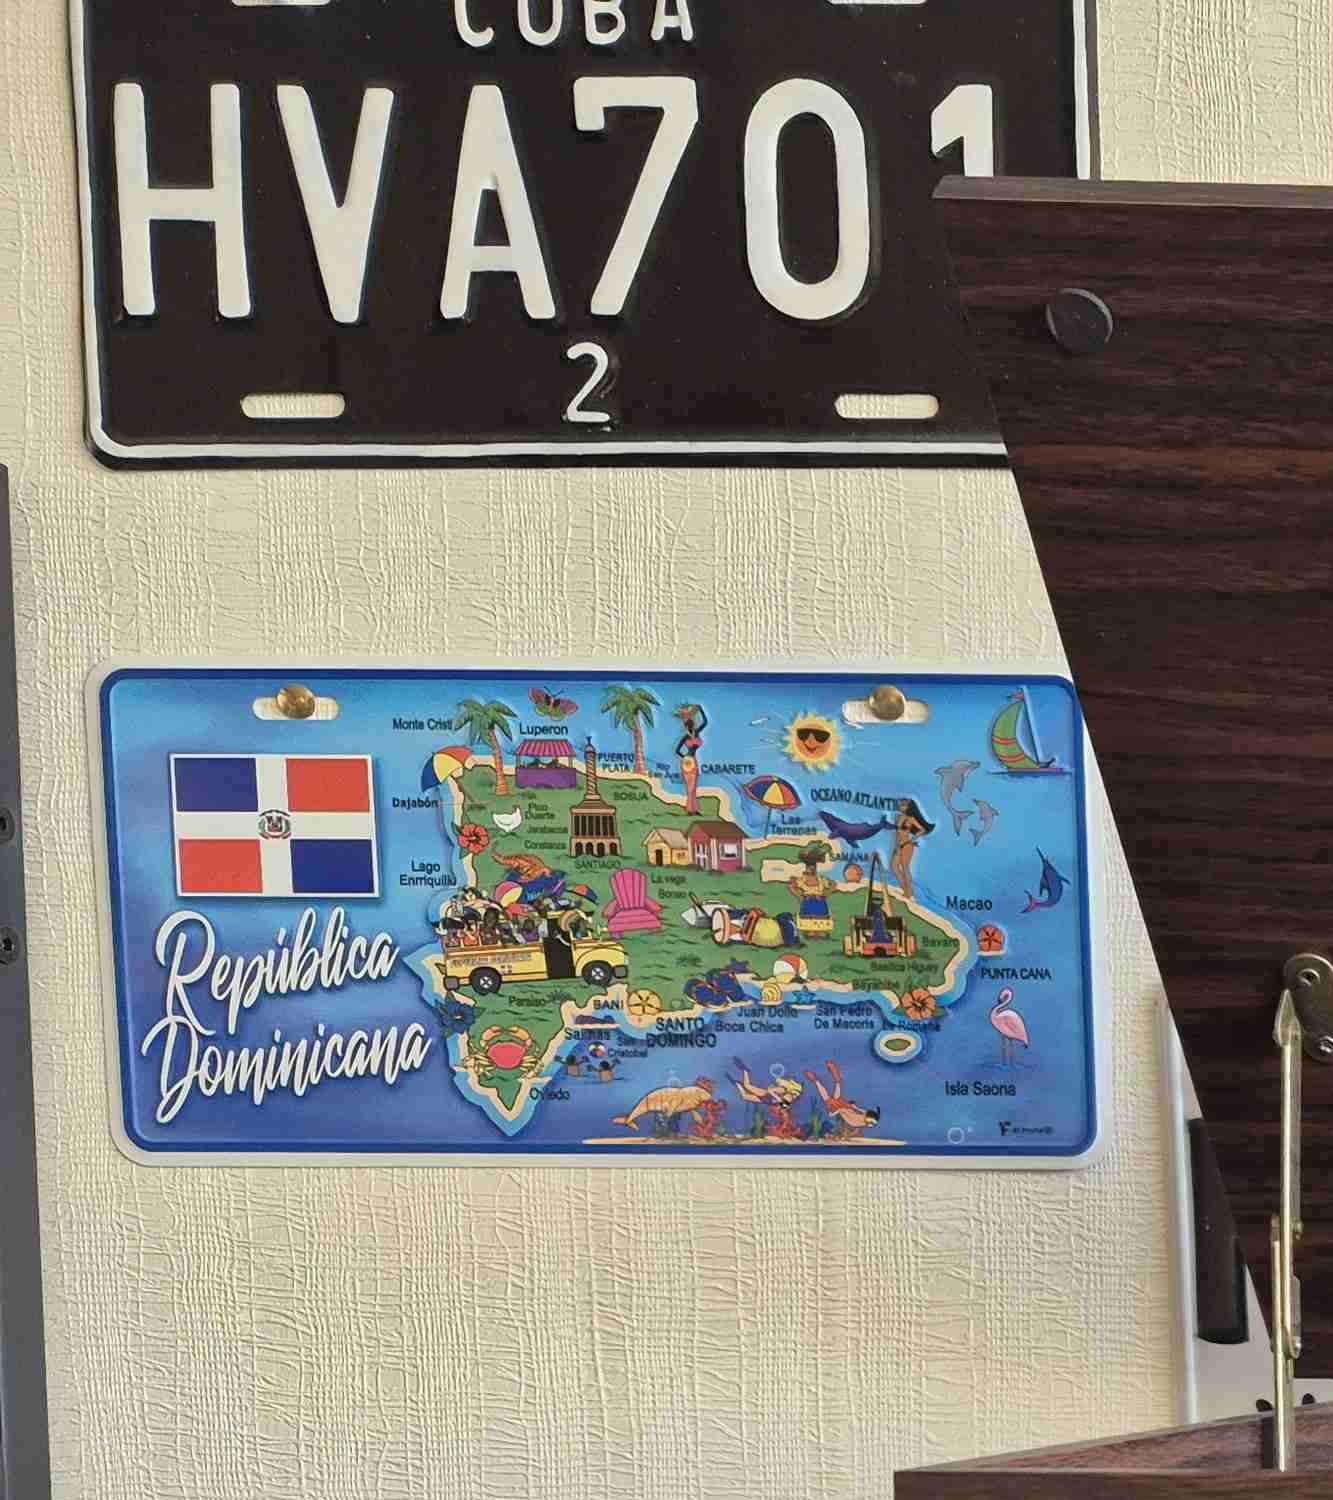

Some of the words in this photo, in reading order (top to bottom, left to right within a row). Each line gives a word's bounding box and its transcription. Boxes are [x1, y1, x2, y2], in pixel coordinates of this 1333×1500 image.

[562, 341, 612, 424] 2
[392, 718, 424, 731] Monte
[519, 722, 568, 737] Luperon
[701, 764, 756, 775] CABARETE
[810, 787, 851, 804] OCEANO
[854, 791, 899, 811] ATLANTI
[411, 860, 441, 875] Lago
[946, 896, 993, 911] Macao
[156, 907, 400, 1036] República
[980, 967, 1018, 980] PUNTA
[1020, 968, 1052, 981] CANA
[656, 1016, 705, 1032] SANTO
[646, 1033, 717, 1049] DOMINGO
[141, 1015, 432, 1124] Dominicana
[945, 1080, 969, 1096] Isla
[973, 1080, 1017, 1096] Saona
